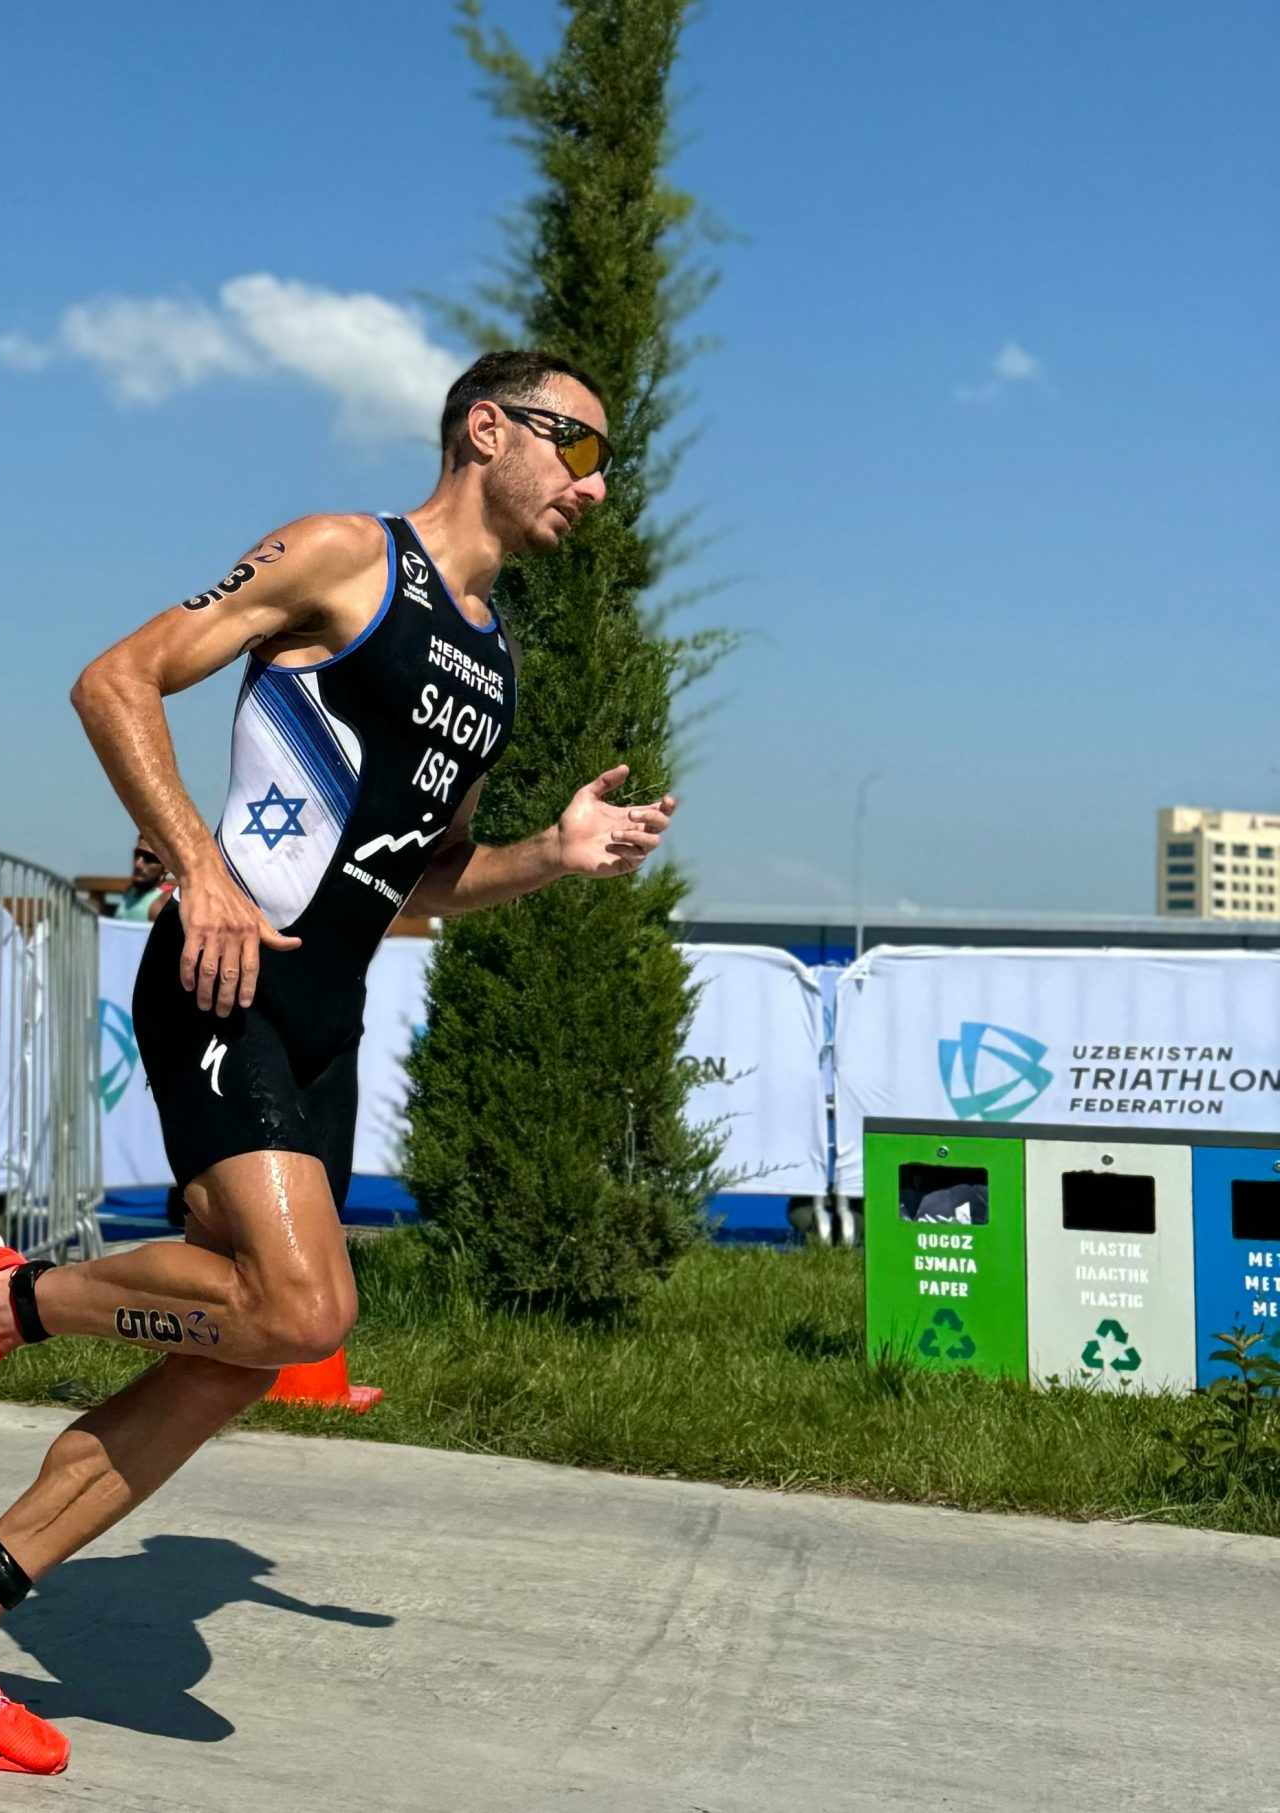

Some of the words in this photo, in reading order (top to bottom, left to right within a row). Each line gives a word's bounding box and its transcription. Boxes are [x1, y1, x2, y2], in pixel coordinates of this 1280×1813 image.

[430, 634, 504, 691] HERBALIFE
[428, 649, 504, 706] NUTRITION
[412, 683, 502, 759] SAGIV
[412, 747, 459, 804] ISR
[1072, 1045, 1234, 1062] UZBEKISTAN
[1069, 1098, 1224, 1115] FEDERATION
[1080, 1239, 1142, 1258] PLASTIK
[914, 1255, 978, 1274] БУМАГА
[1075, 1265, 1149, 1284] ПЛАСТИК
[919, 1280, 969, 1297] PAPER
[1080, 1290, 1144, 1309] PLASTIC
[115, 1307, 185, 1344] 35
